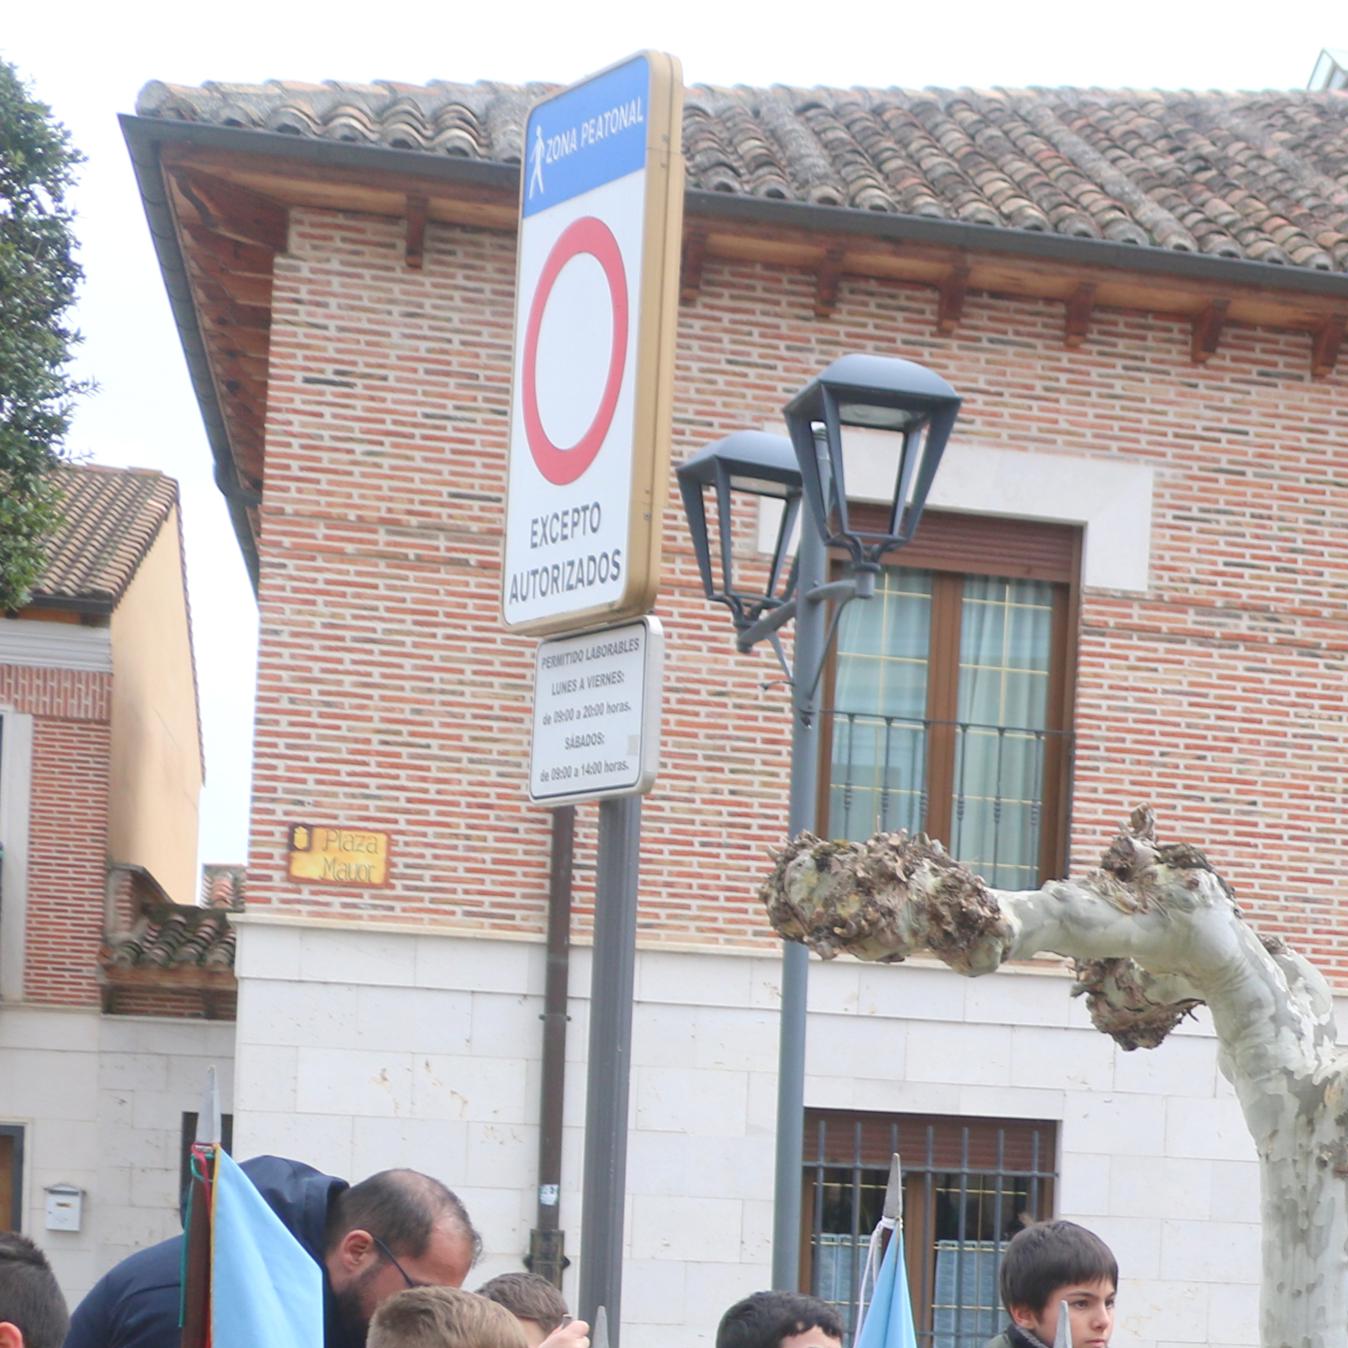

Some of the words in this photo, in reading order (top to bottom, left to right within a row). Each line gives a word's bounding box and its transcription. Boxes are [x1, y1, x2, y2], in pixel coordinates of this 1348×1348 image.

[545, 127, 577, 164] ZONA
[580, 96, 644, 148] PEATONAL
[530, 501, 601, 549] EXCEPTO
[508, 548, 622, 604] AUTORIZADOS
[541, 649, 584, 670] PERMITIDO
[586, 637, 640, 660] LABORABLES
[551, 679, 578, 696] LUNES
[579, 676, 585, 690] A
[586, 669, 625, 689] VIERNES:
[542, 713, 552, 726] de
[576, 709, 582, 720] a
[583, 702, 605, 719] 20:00
[606, 701, 632, 715] horas.
[540, 769, 550, 782] de
[574, 767, 579, 777] a
[581, 761, 603, 776] 14:00
[604, 760, 630, 774] horas.
[321, 829, 379, 855] Plaza
